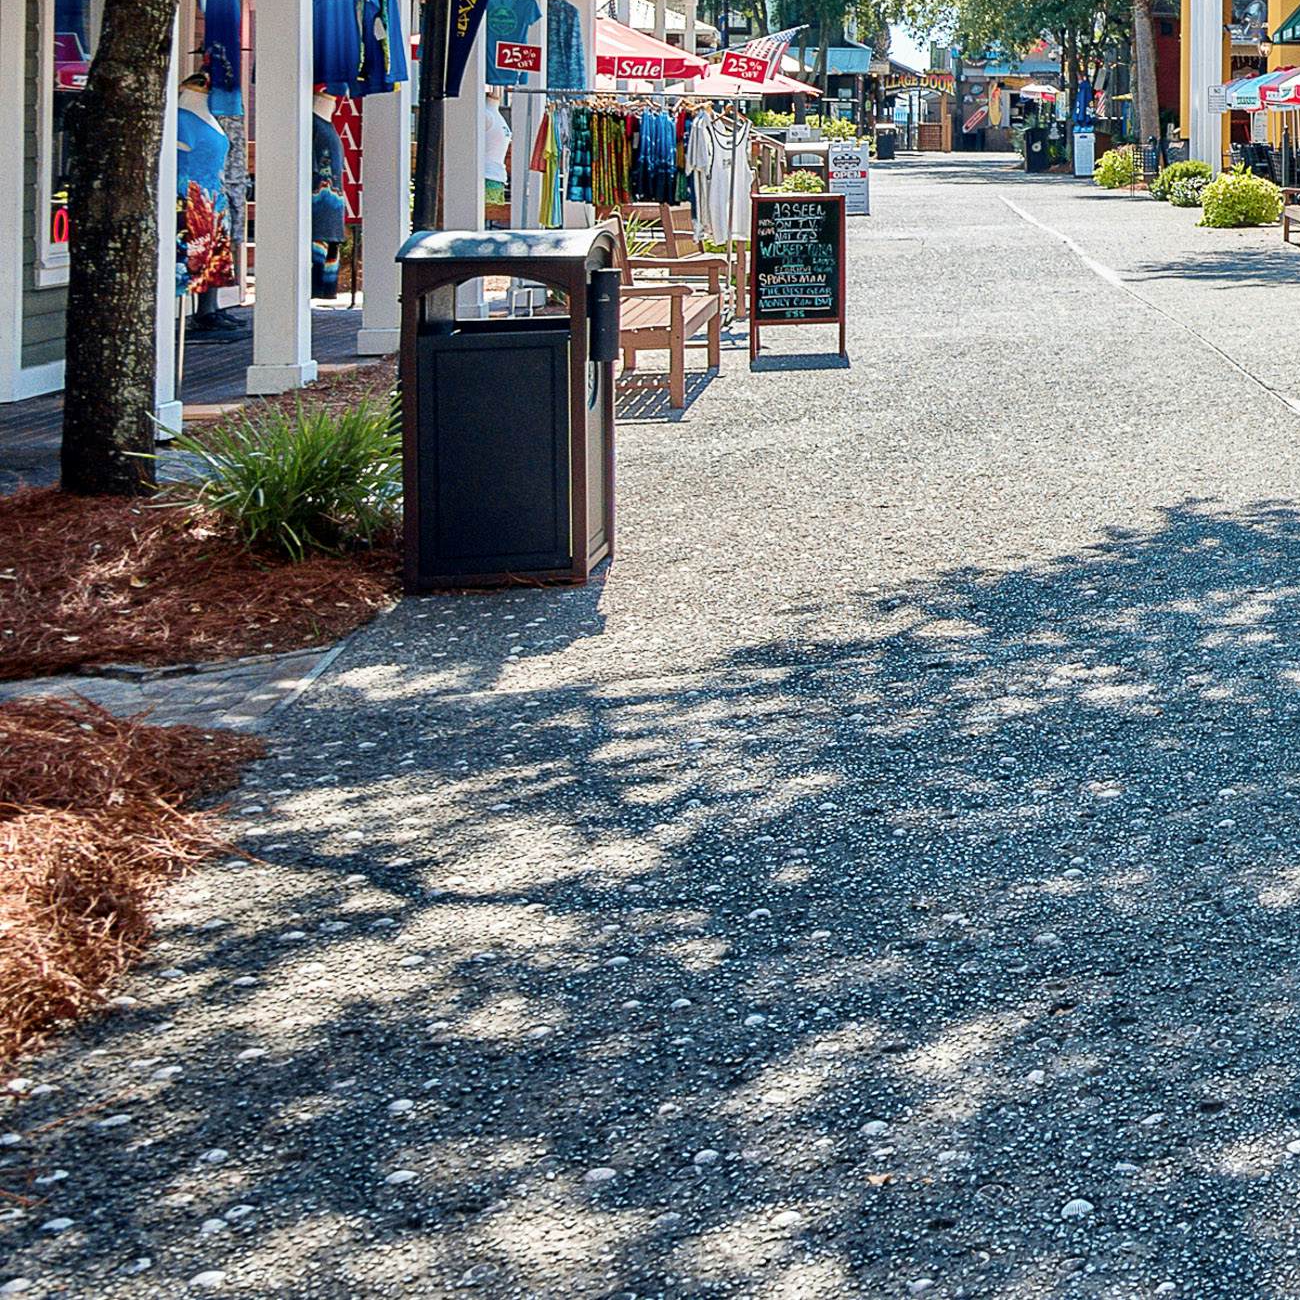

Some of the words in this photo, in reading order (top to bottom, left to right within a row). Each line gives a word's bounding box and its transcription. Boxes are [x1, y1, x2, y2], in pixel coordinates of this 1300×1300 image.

[502, 46, 537, 63] 25%
[517, 59, 535, 69] OFF
[618, 60, 661, 78] Sale
[728, 58, 763, 74] 25%
[741, 70, 760, 79] OFF
[833, 171, 861, 179] OPEN
